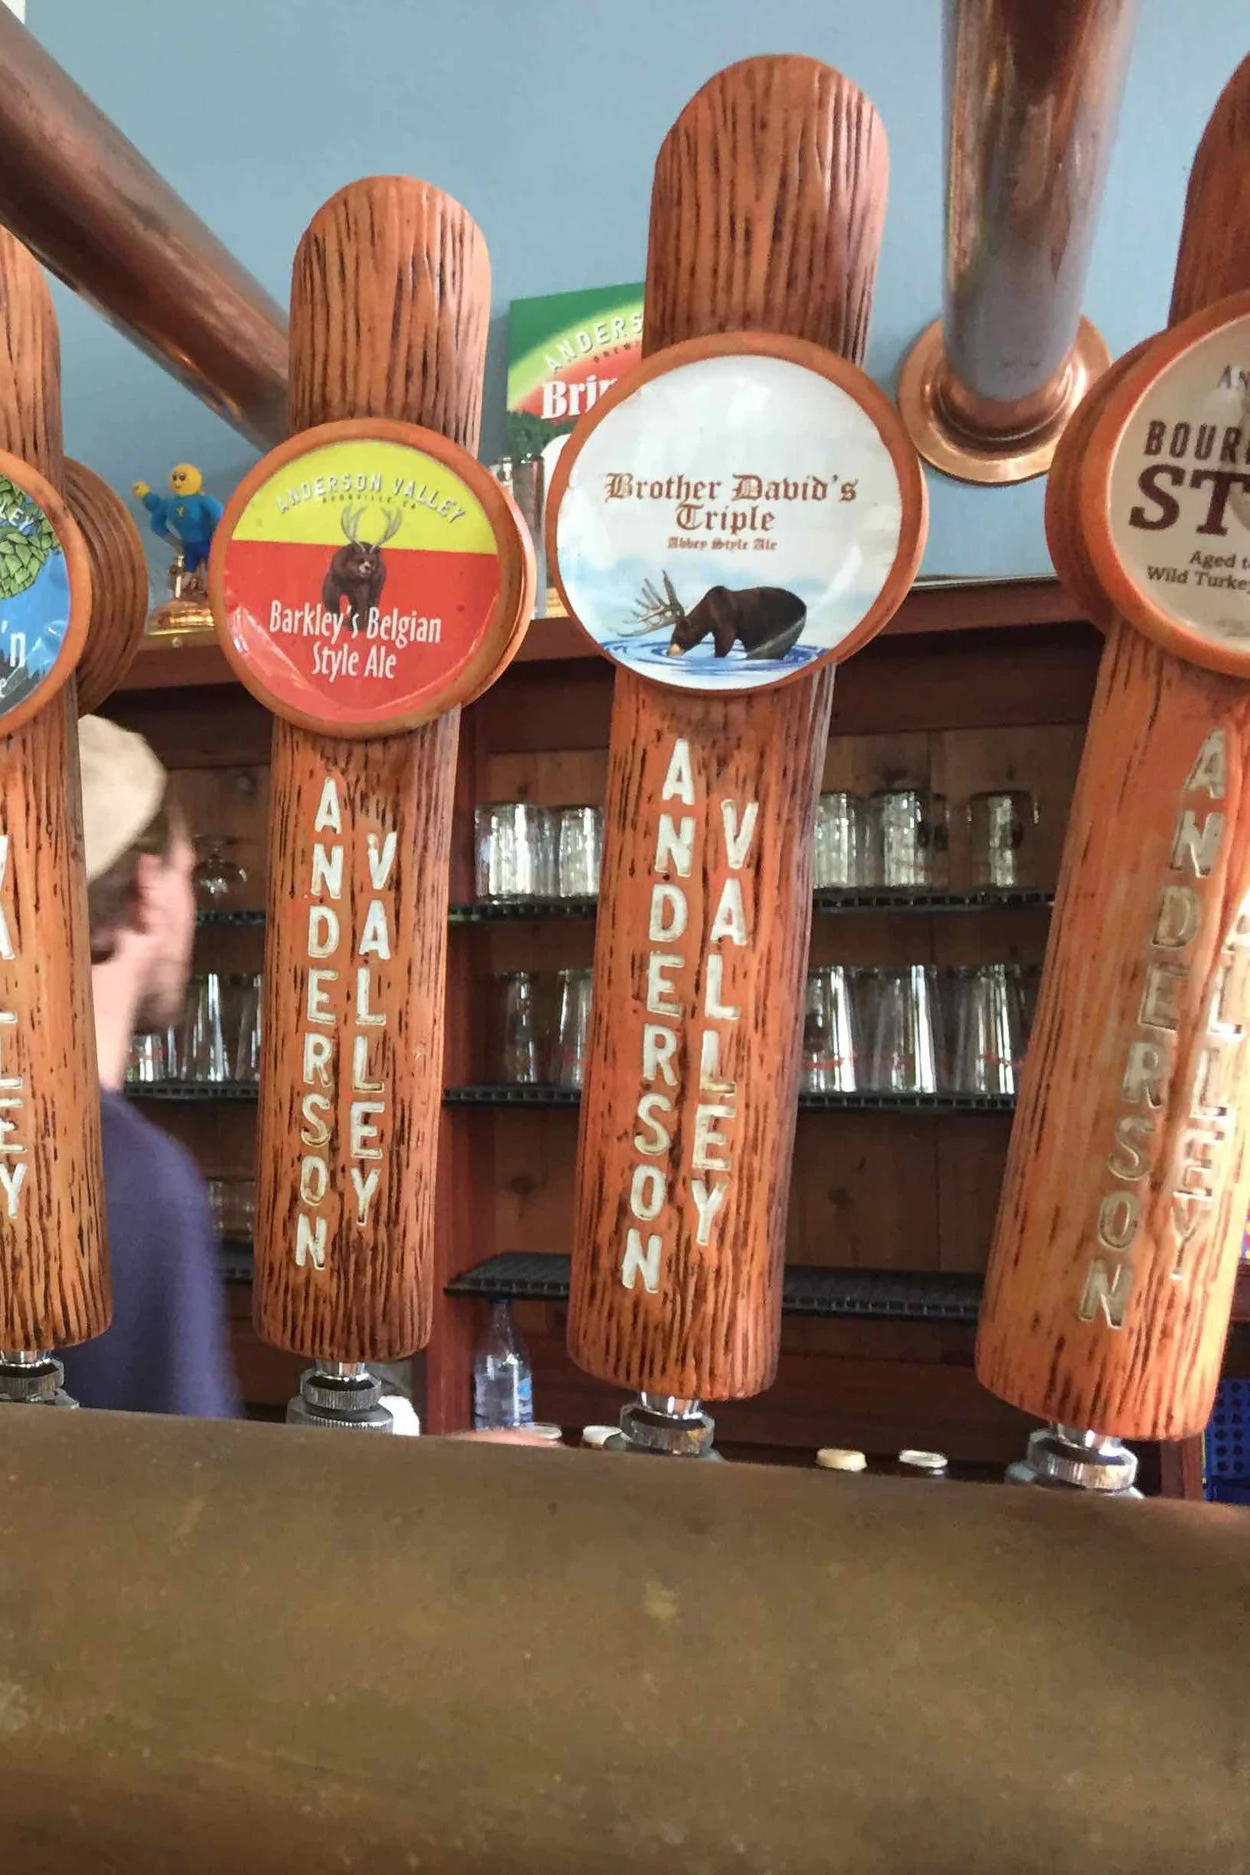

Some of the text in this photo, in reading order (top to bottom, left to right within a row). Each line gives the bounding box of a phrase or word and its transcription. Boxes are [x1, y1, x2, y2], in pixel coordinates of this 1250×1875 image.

[1143, 420, 1250, 465] BOUR
[275, 472, 467, 524] ANDERSON VALLEY
[605, 472, 858, 504] Brother David's
[675, 502, 775, 536] Triple
[753, 537, 778, 551] Ale
[1189, 550, 1237, 571] Aged
[1147, 565, 1189, 585] Wild
[269, 600, 441, 649] Barkley's Belgian
[312, 641, 397, 683] Style Ale
[295, 776, 344, 1271] ANDERSON
[350, 831, 397, 1226] VALLEY
[621, 737, 699, 1294] ANDERSON
[689, 798, 759, 1247] VALLEY
[1077, 728, 1227, 1331] ANDERSON
